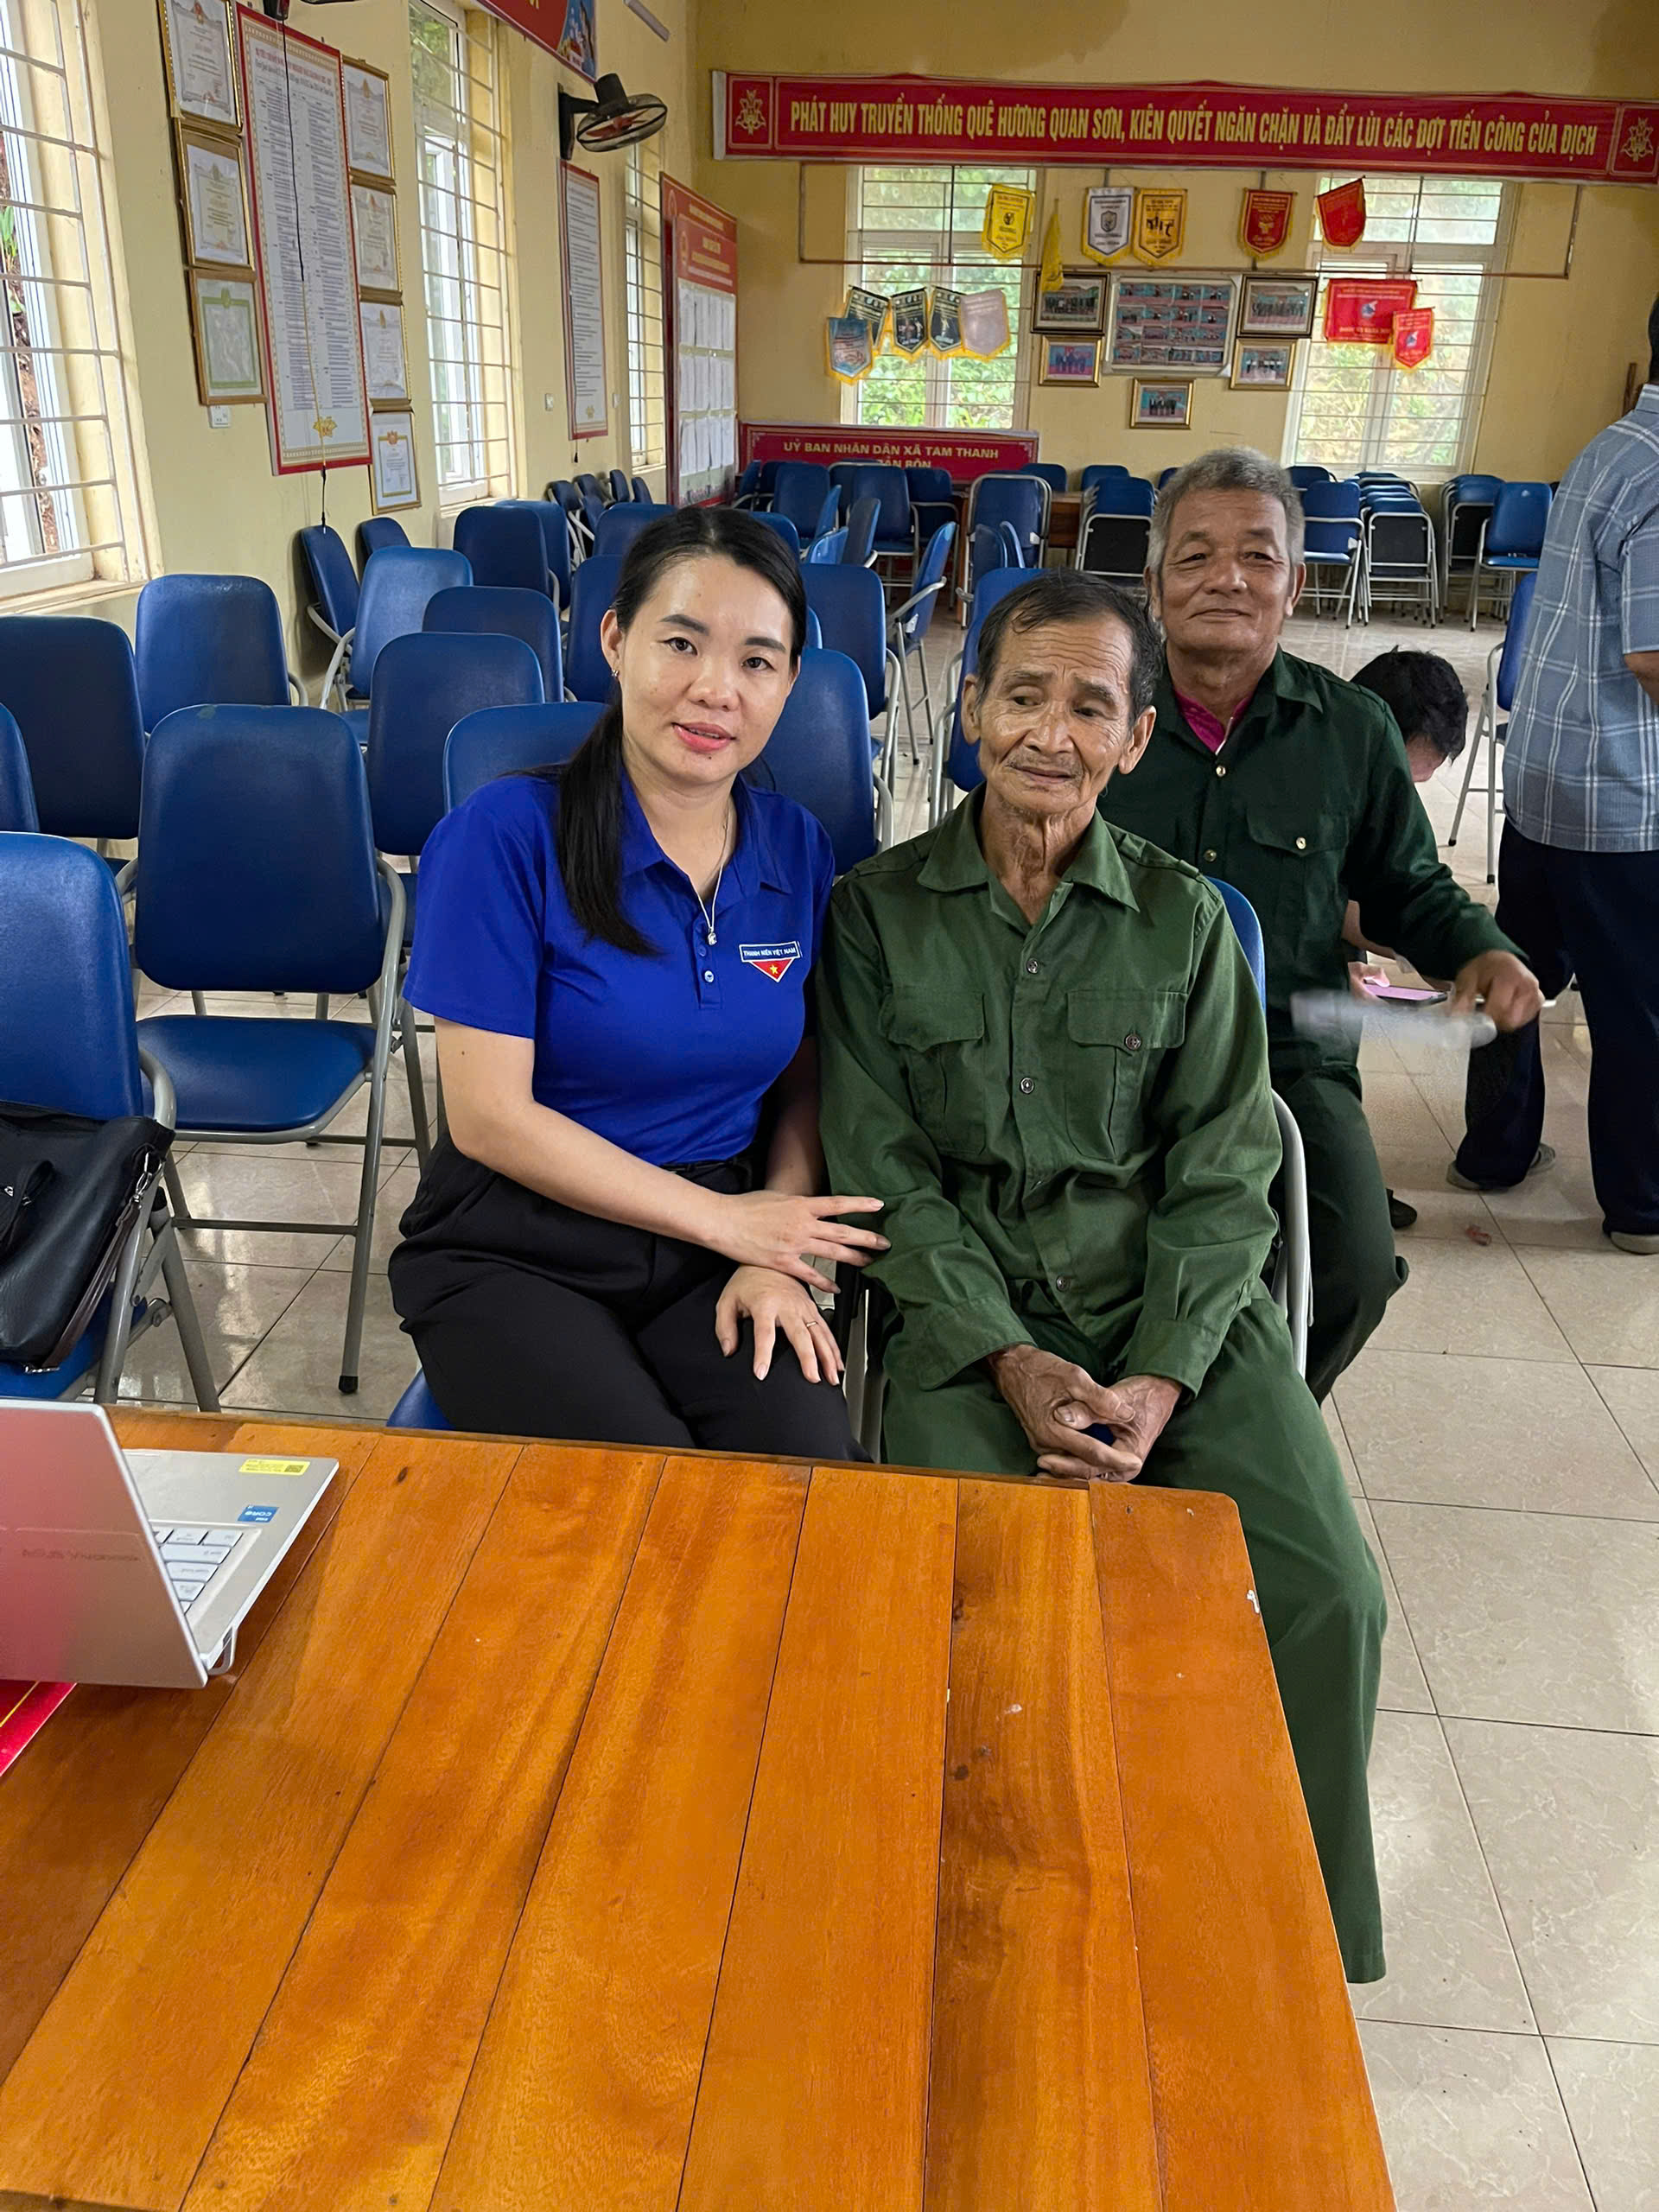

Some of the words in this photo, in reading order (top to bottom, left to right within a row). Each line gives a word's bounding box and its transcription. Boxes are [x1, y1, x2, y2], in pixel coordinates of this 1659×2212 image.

[791, 95, 826, 131] PHÁT
[830, 101, 858, 133] HUY
[861, 92, 913, 134] TRUYỀN
[918, 93, 963, 136] THỐNG
[967, 99, 994, 140] QUÊ
[997, 104, 1046, 137] HƯƠNG
[1049, 107, 1090, 142] QUAN
[1092, 106, 1126, 143] SƠN,
[1129, 103, 1165, 140] KIÊN
[1167, 99, 1213, 144] QUYẾT
[1214, 105, 1257, 143] NGĂN
[1259, 106, 1300, 150] CHẶN
[1303, 107, 1321, 144] VÀ
[1324, 103, 1356, 146] ĐẨY
[1356, 111, 1381, 147] LÙI
[1383, 111, 1414, 149] CÁC
[1415, 116, 1446, 156] ĐỢT
[1449, 109, 1483, 150] TIẾN
[1484, 114, 1525, 152] CÔNG
[1528, 110, 1558, 154] CỦA
[1560, 124, 1598, 162] ĐỊCH
[784, 438, 801, 452] UỶ
[804, 442, 830, 453] BAN
[834, 442, 869, 454] NHÂN
[873, 442, 899, 455] DÂN
[904, 443, 921, 456] XÃ
[925, 446, 952, 457] TAM
[955, 448, 999, 458] THANH
